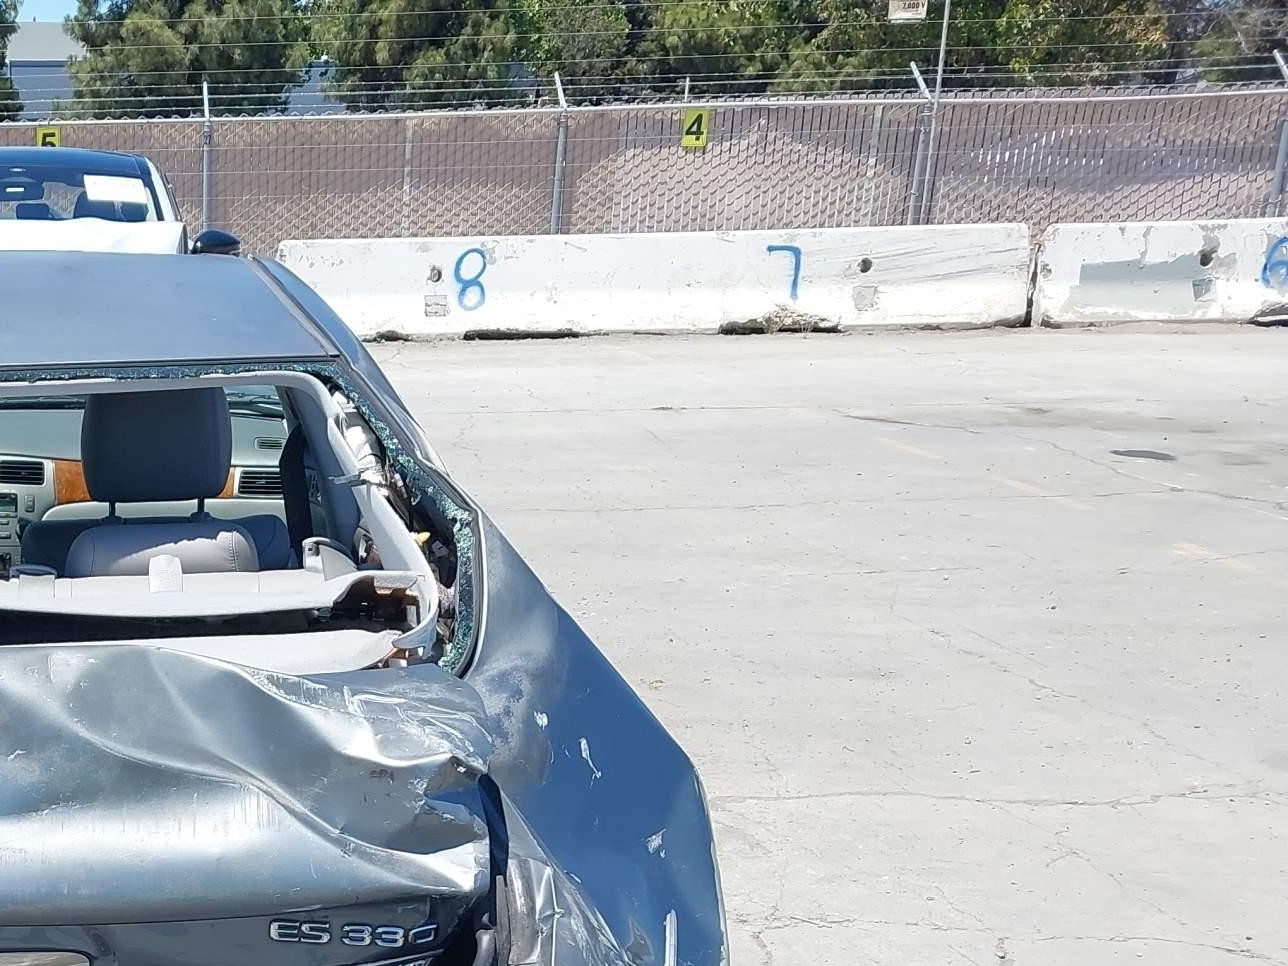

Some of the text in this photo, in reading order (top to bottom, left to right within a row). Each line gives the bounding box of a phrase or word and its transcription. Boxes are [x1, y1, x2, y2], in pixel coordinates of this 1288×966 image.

[41, 132, 57, 147] 5
[685, 113, 704, 141] 4
[454, 247, 487, 312] 8
[766, 245, 802, 301] 7
[269, 920, 438, 948] ES 330
